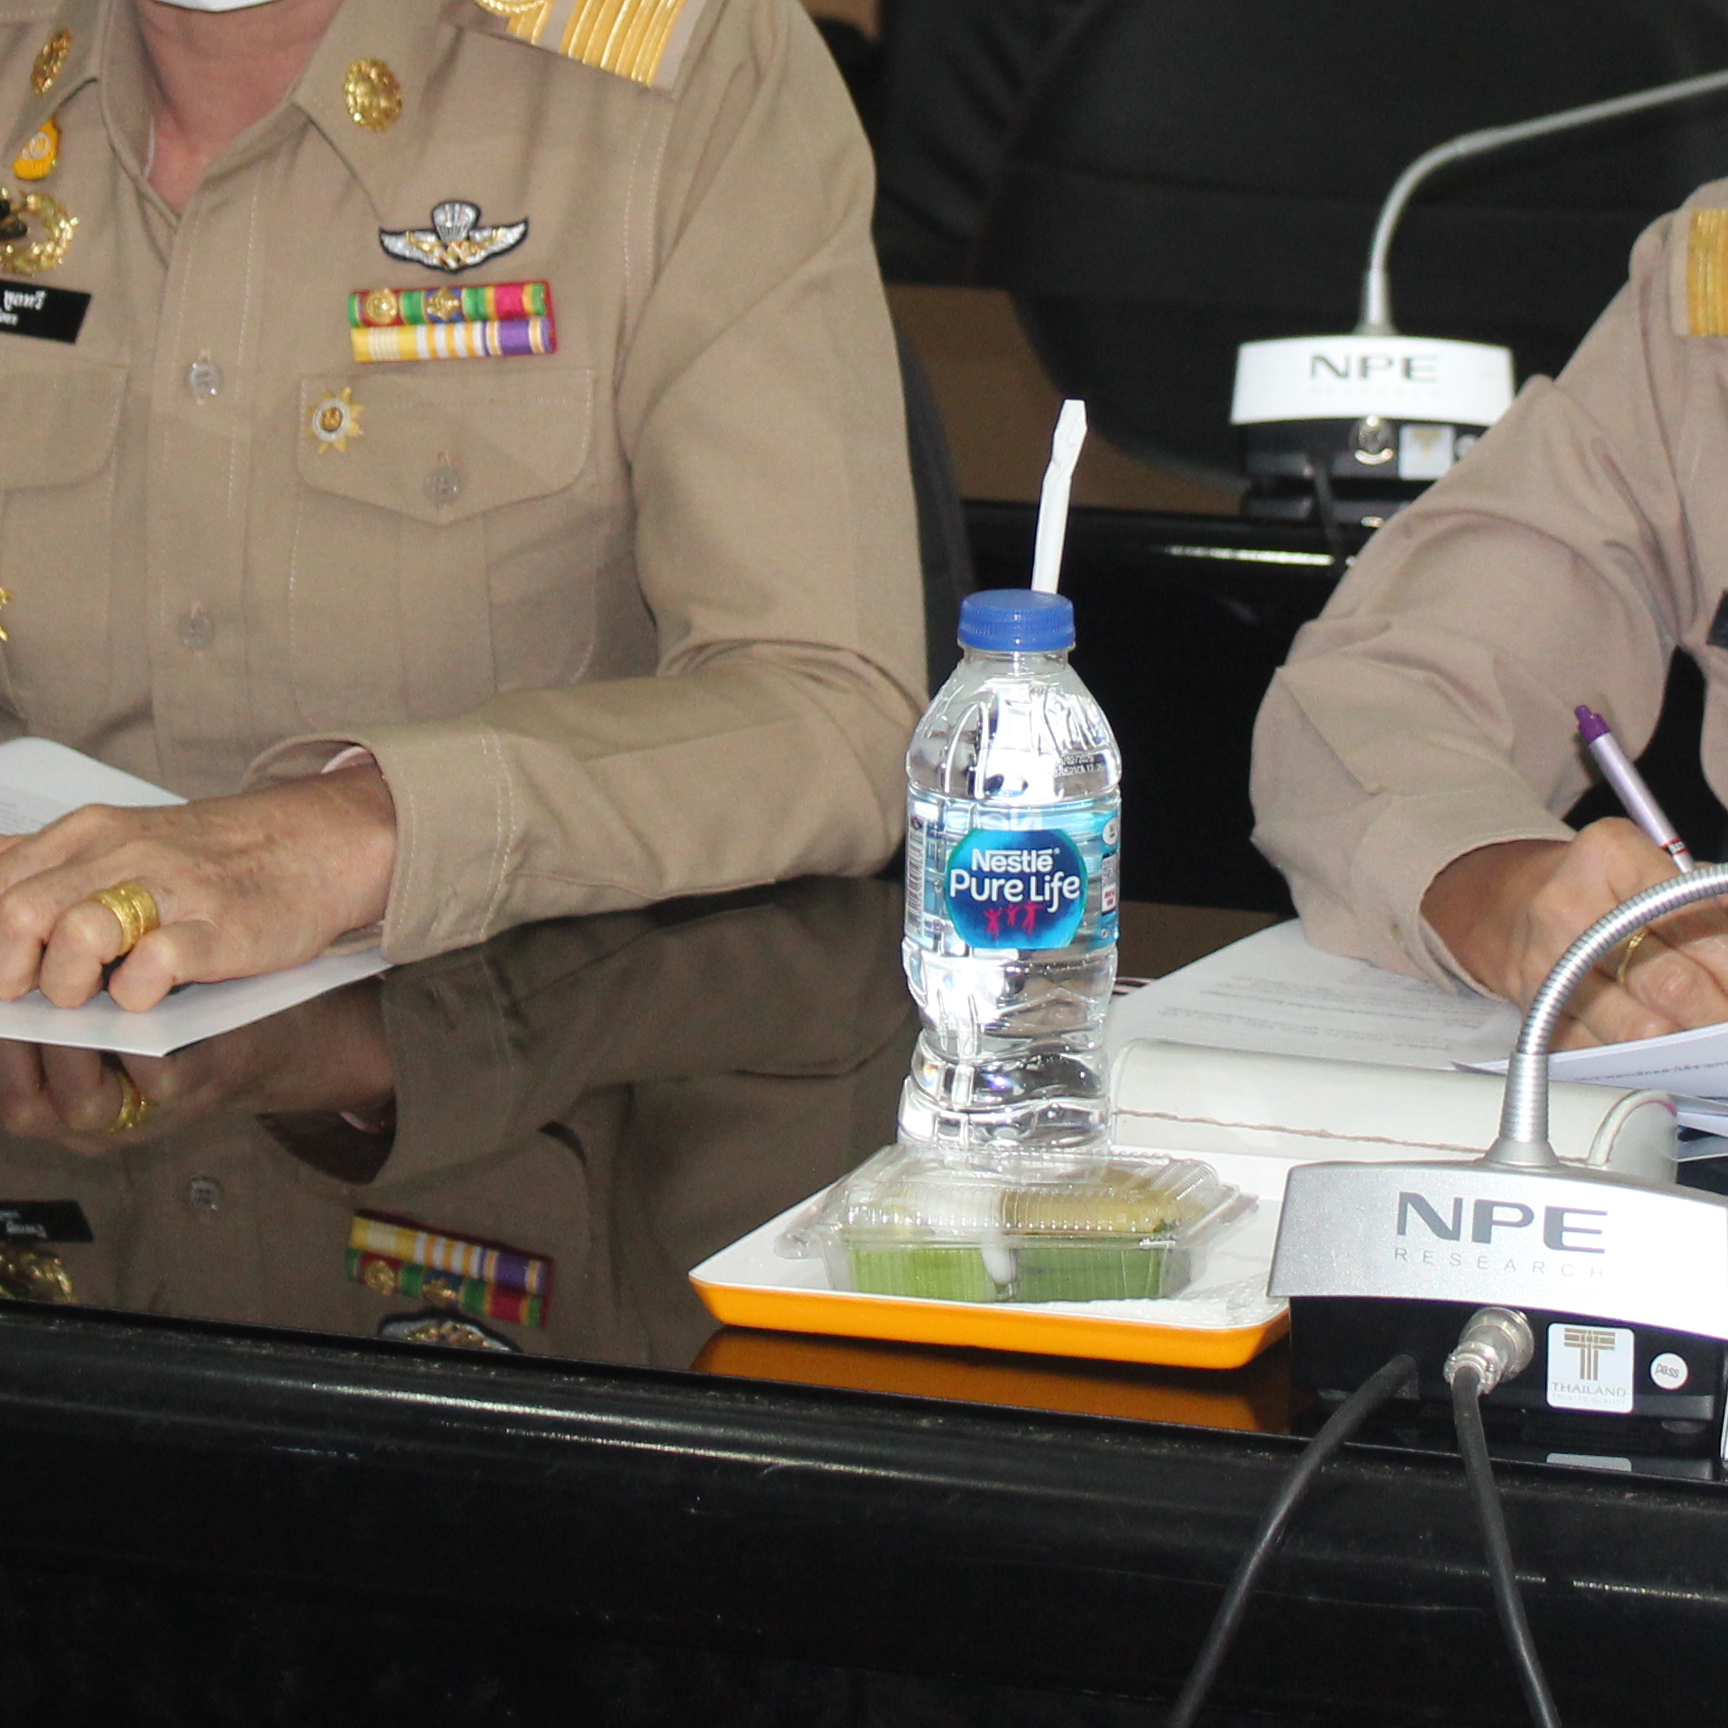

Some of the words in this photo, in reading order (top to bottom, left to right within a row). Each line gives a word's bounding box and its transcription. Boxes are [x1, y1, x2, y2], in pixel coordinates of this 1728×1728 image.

[1309, 354, 1438, 382] NPE
[949, 869, 1023, 902] Pure
[1030, 871, 1081, 913] Life
[1396, 1191, 1608, 1254] NPE
[1394, 1246, 1604, 1280] RESEARCH
[1655, 1363, 1680, 1379] pass
[1551, 1382, 1627, 1398] THAILAND
